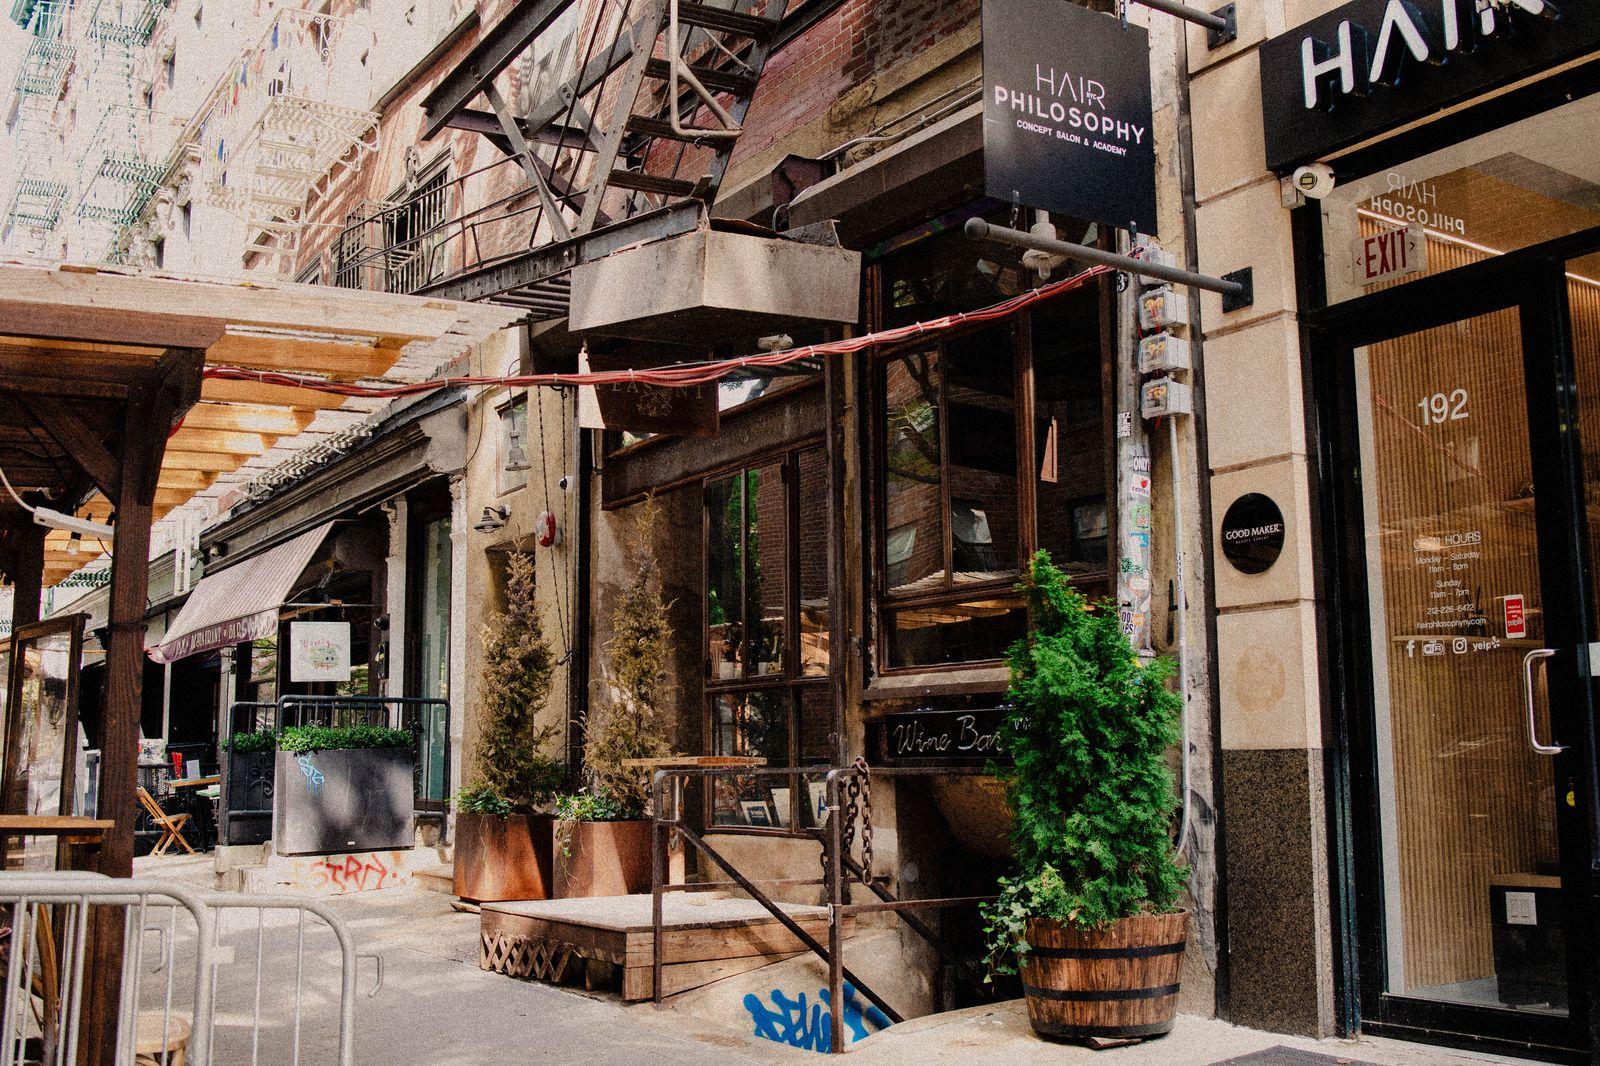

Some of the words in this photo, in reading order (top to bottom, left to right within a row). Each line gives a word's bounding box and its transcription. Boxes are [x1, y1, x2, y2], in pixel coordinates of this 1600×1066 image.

[1301, 0, 1545, 109] HAI
[1036, 63, 1106, 110] HAIR
[994, 84, 1145, 144] PHILOSOPHY
[1016, 119, 1053, 136] CONCEPT
[1056, 130, 1081, 144] SALON
[1083, 138, 1089, 146] &
[1093, 140, 1127, 156] ACADEMY
[1364, 227, 1408, 279] EXIT
[1418, 388, 1469, 426] 192
[1226, 528, 1250, 540] GOOD
[1251, 523, 1281, 536] MAKER
[1444, 531, 1481, 546] HOURS
[1415, 555, 1441, 565] Monday
[1450, 550, 1480, 561] Saturday
[1453, 562, 1469, 572] 8pm
[1436, 579, 1462, 589] Sunday
[1455, 588, 1470, 597] 7pm
[1472, 641, 1492, 652] yelp
[893, 720, 952, 754] Wine
[956, 715, 1003, 751] Bar
